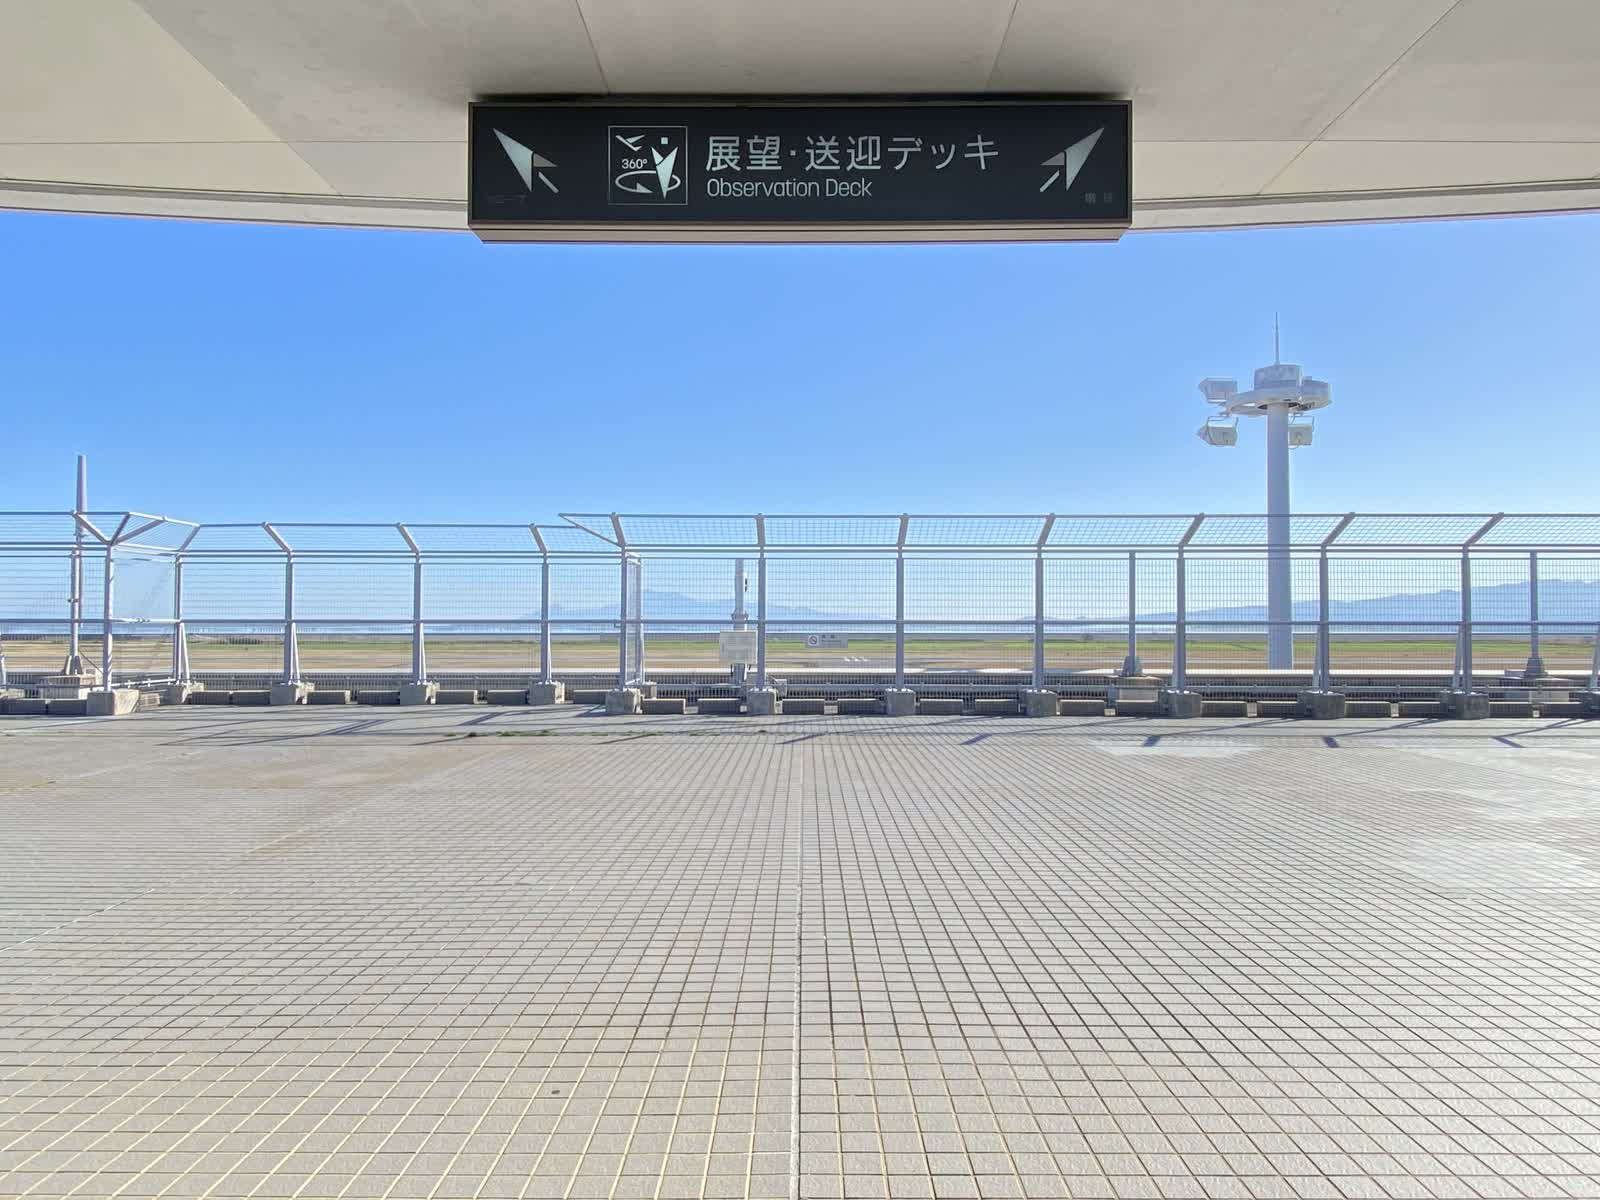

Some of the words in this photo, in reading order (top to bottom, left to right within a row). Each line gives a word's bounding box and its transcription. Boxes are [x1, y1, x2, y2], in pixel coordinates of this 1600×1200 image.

[706, 134, 999, 172] 展望・送迎デッキ
[706, 177, 820, 198] Observation
[825, 177, 873, 198] Deck
